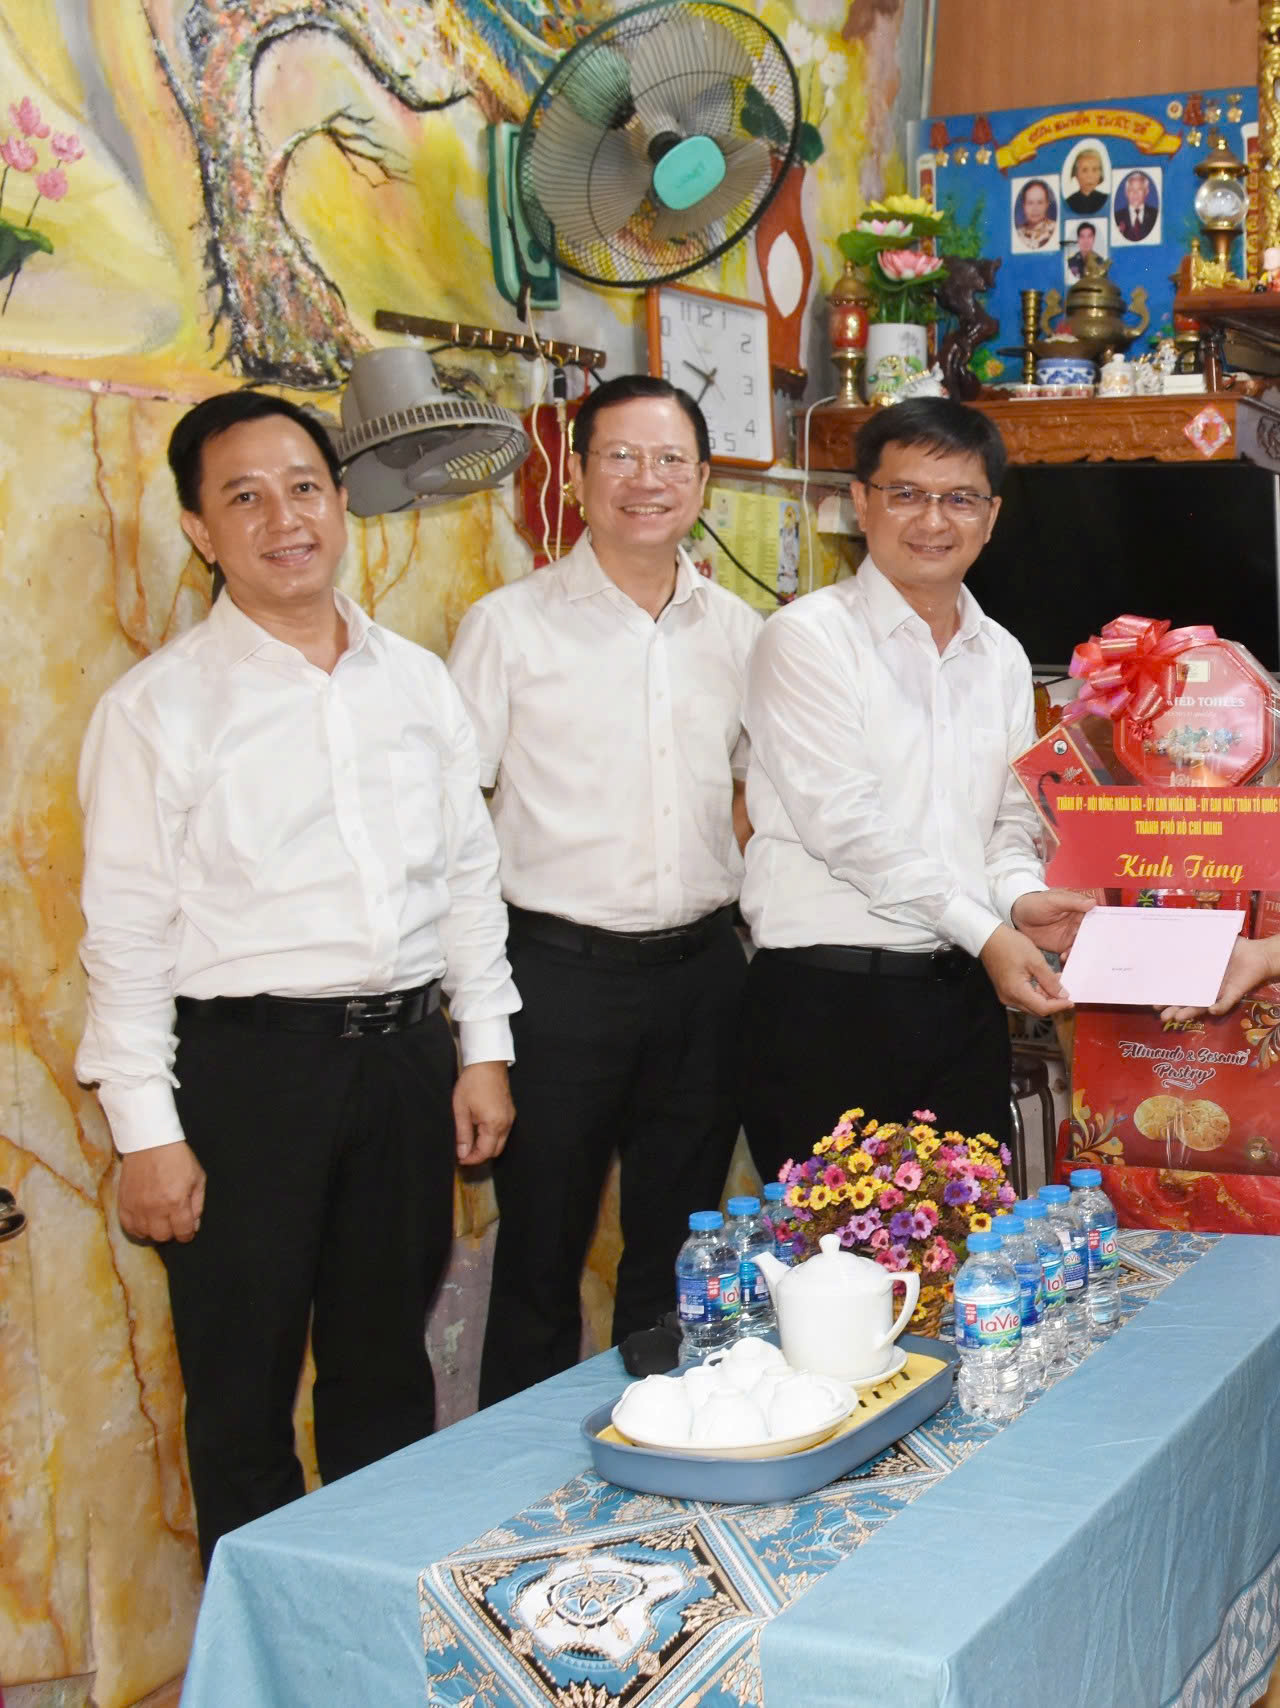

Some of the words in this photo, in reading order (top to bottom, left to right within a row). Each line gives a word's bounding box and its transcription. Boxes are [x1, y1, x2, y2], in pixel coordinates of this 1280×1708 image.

[1135, 818, 1159, 835] THÀNH
[1160, 816, 1175, 835] PHỐ
[1188, 818, 1202, 836] CHÍ
[1203, 820, 1223, 836] MINH
[1114, 854, 1175, 878] Kính
[1183, 854, 1245, 884] Tặng
[1119, 1041, 1184, 1062] Almond
[1186, 1050, 1196, 1061] &
[1197, 1047, 1251, 1066] Sesame
[1152, 1062, 1217, 1085] Pastry
[980, 1313, 1020, 1333] laVie
